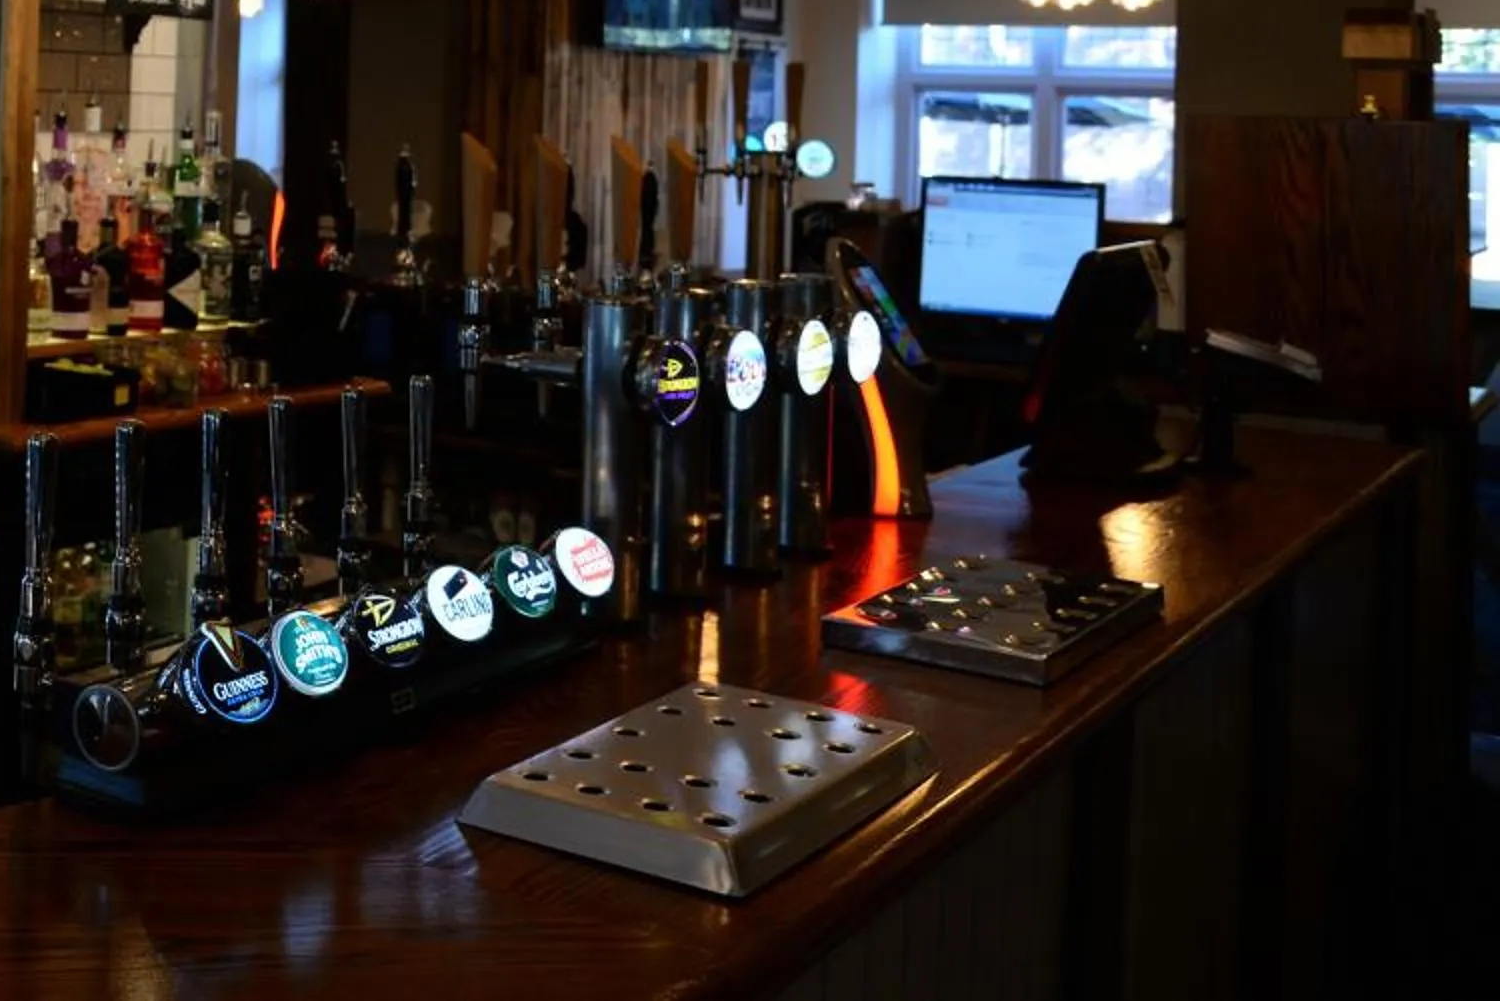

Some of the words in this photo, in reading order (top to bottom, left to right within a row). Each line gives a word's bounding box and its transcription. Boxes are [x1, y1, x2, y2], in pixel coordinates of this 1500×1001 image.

[441, 591, 493, 621] CARLING
[296, 631, 329, 653] JOHN
[213, 670, 269, 701] GUINNESS
